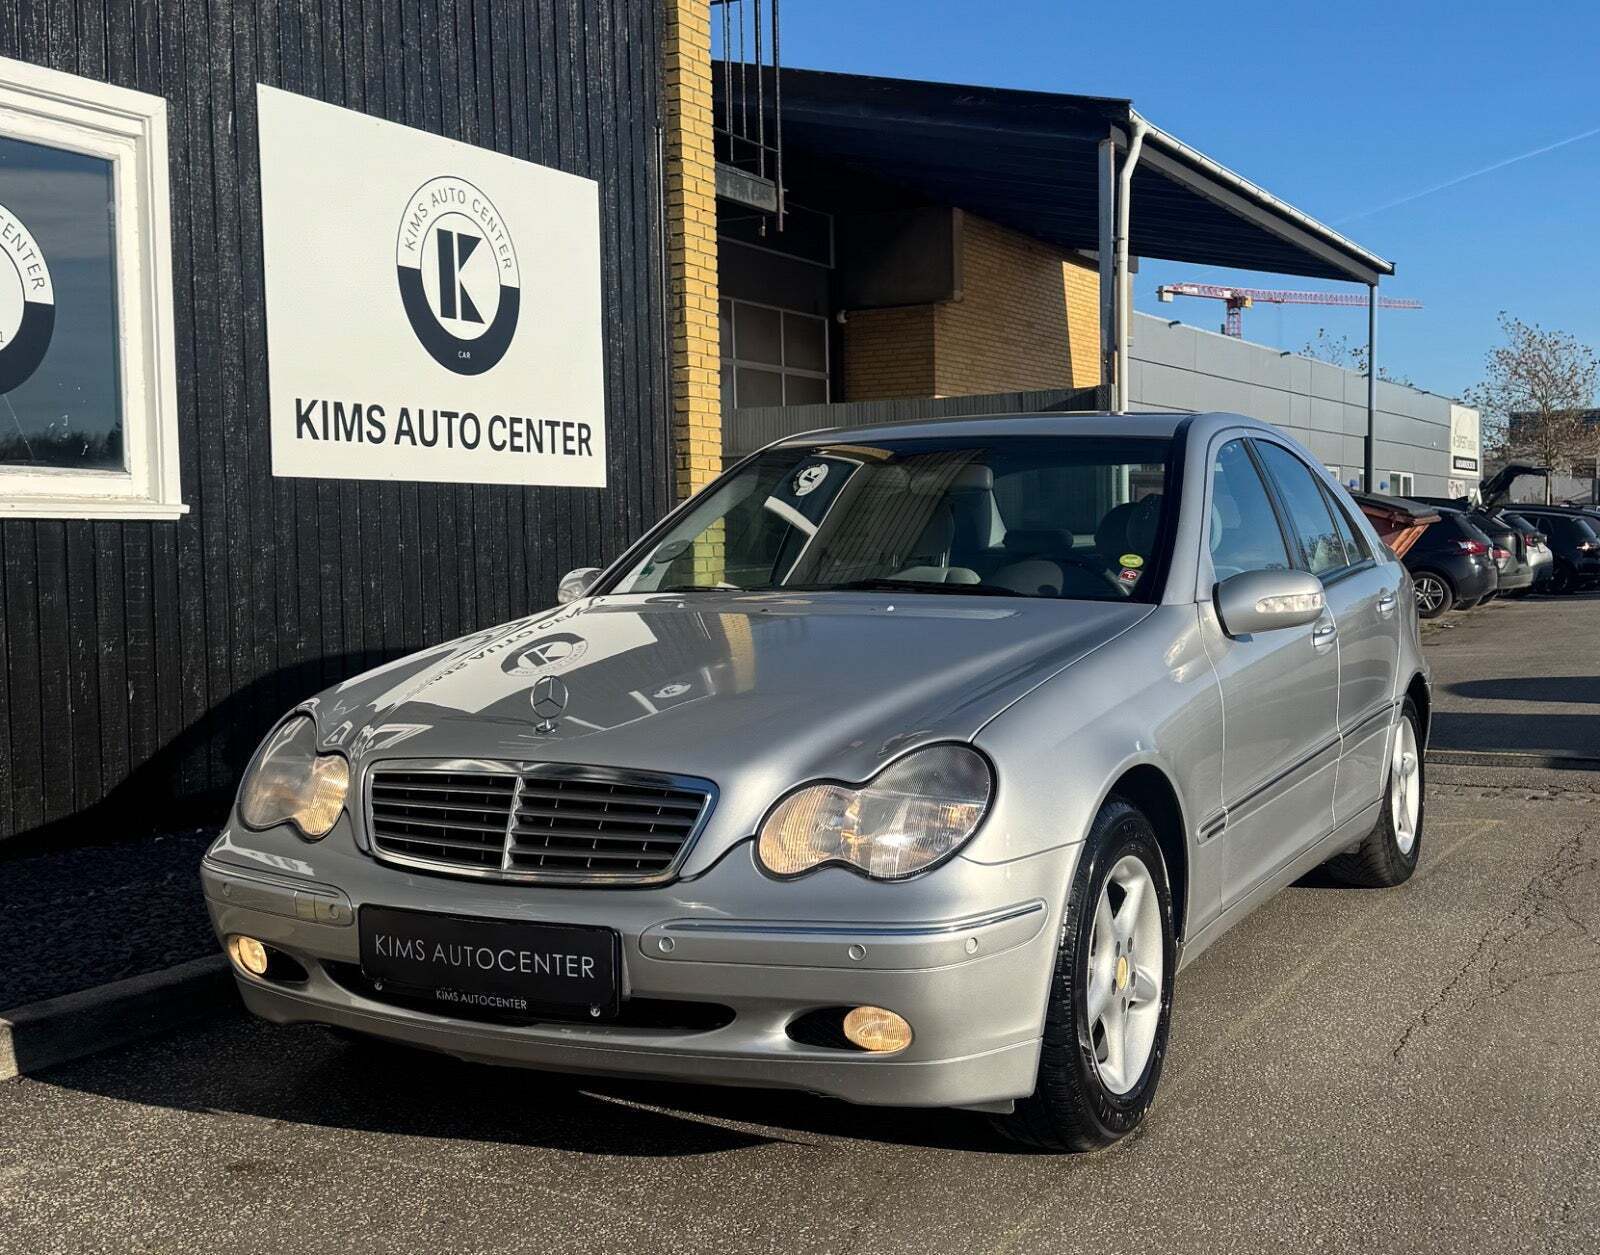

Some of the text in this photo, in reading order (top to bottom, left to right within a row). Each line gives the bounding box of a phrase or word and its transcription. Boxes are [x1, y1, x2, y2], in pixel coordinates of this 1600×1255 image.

[0, 216, 45, 290] ENTER
[405, 187, 512, 270] KIMS AUTO CENTER
[436, 228, 485, 325] K
[457, 350, 471, 360] CAR
[295, 398, 593, 457] KIMS AUTO CENTER
[375, 934, 595, 979] KIMS AUTOCENTER
[435, 990, 527, 1010] KIMS AUTOCENTER
